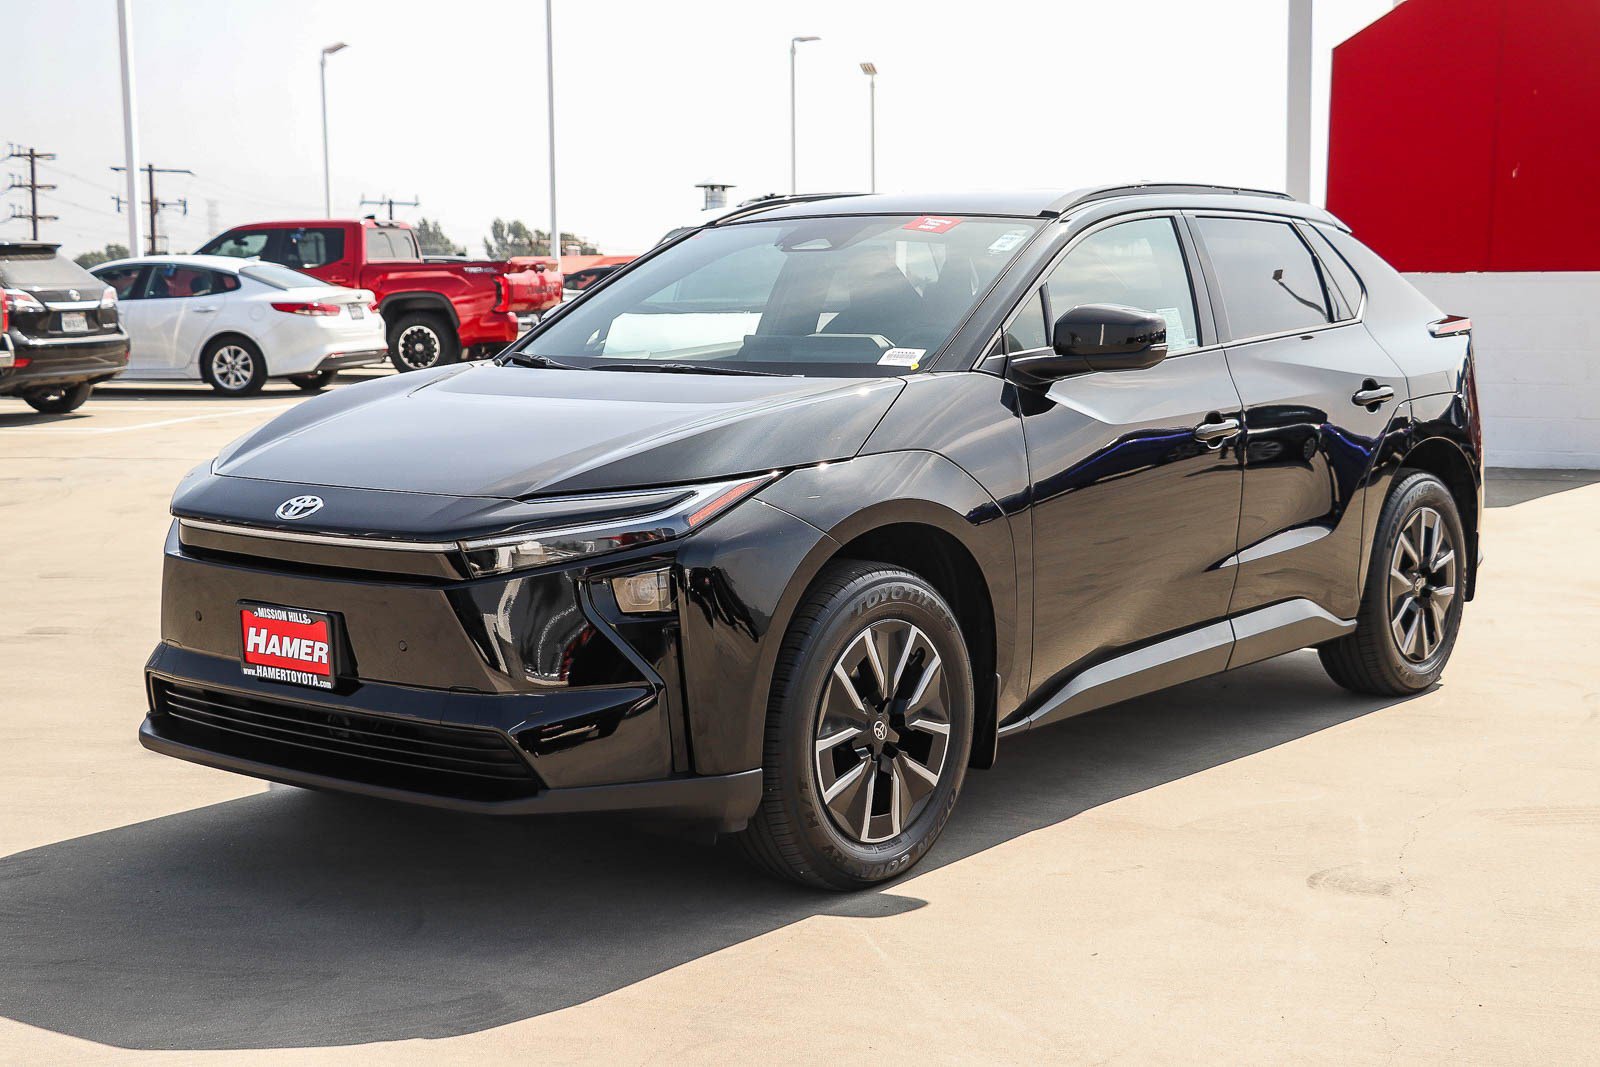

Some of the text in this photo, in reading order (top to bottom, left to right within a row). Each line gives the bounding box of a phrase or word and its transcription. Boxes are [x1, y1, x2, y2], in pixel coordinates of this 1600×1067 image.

[855, 586, 905, 616] TOYO
[257, 608, 308, 624] MISSION HILLS
[247, 627, 329, 664] HAMER
[243, 665, 331, 689] www.HAMERTOYOTA.com
